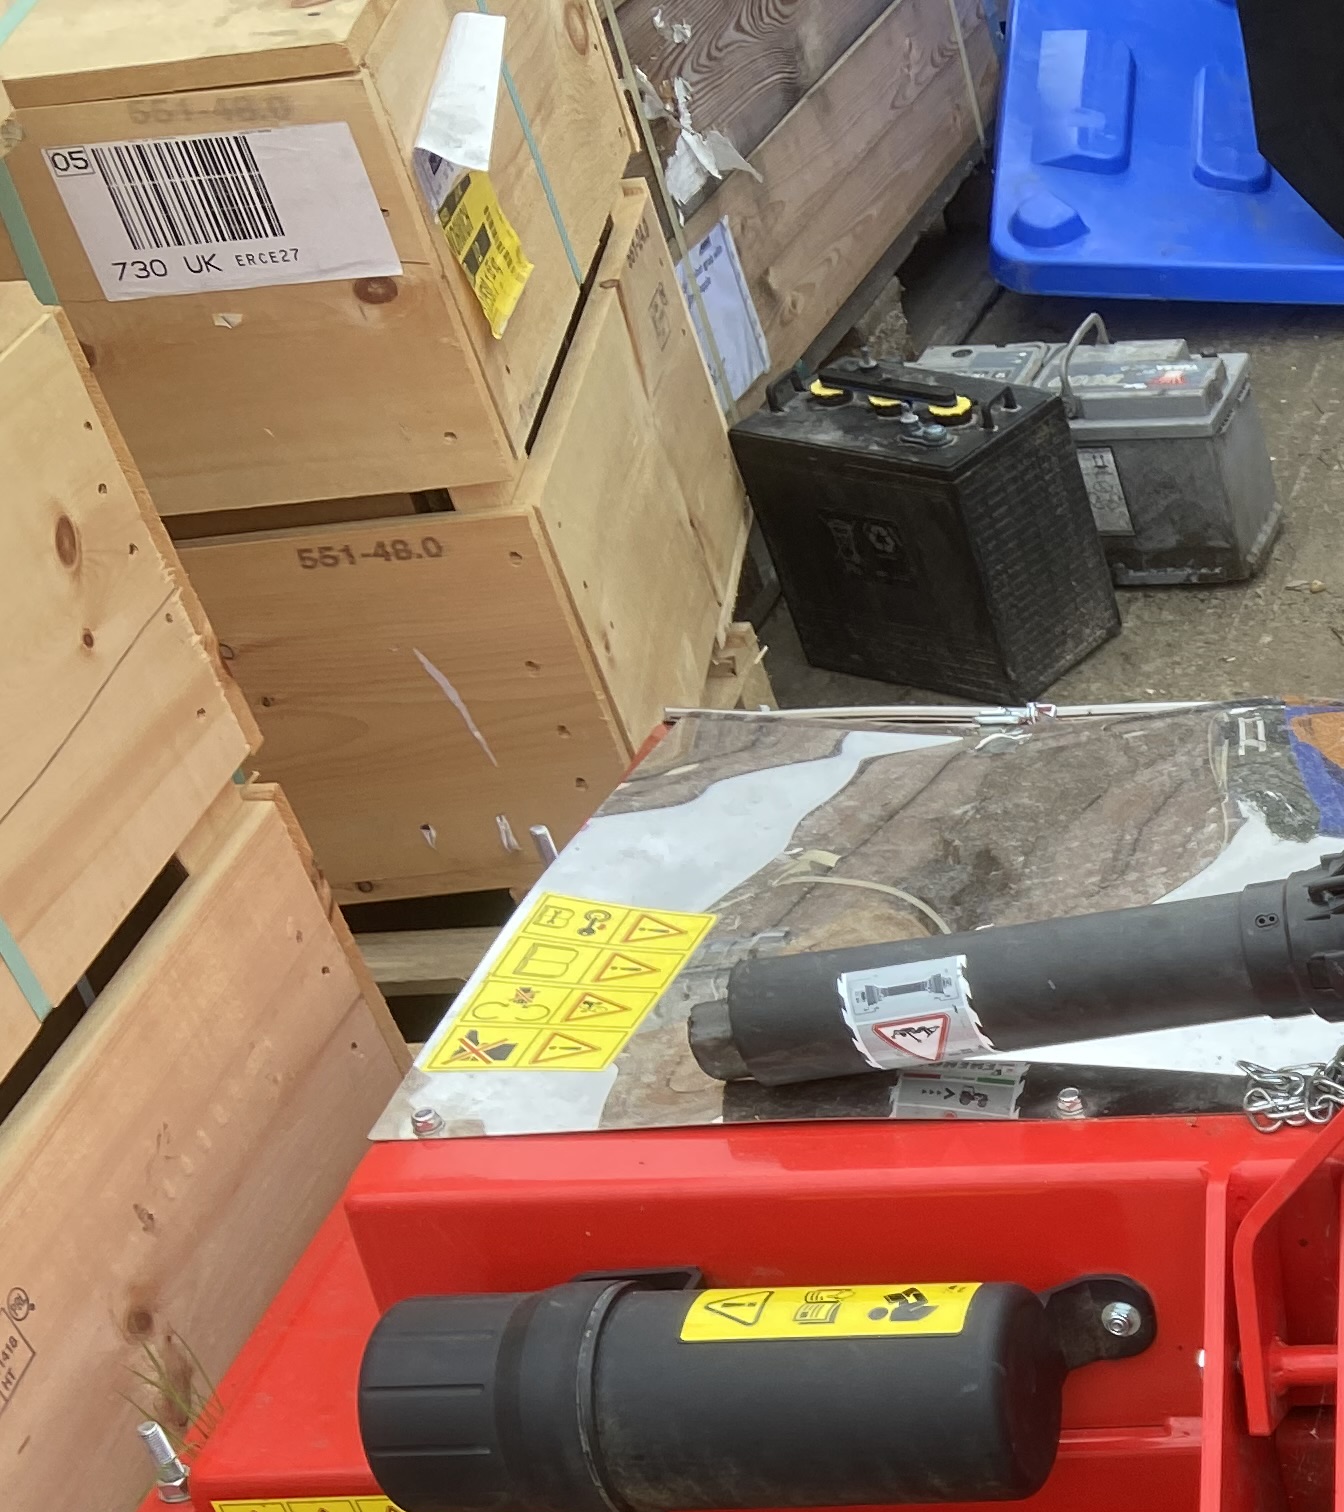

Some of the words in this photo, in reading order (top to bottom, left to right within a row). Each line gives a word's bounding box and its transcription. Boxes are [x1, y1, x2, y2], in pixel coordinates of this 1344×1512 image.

[51, 150, 90, 172] 05
[111, 259, 168, 281] 730
[183, 254, 223, 273] UK
[234, 248, 300, 268] ERCE27
[297, 536, 444, 569] 551-48.0
